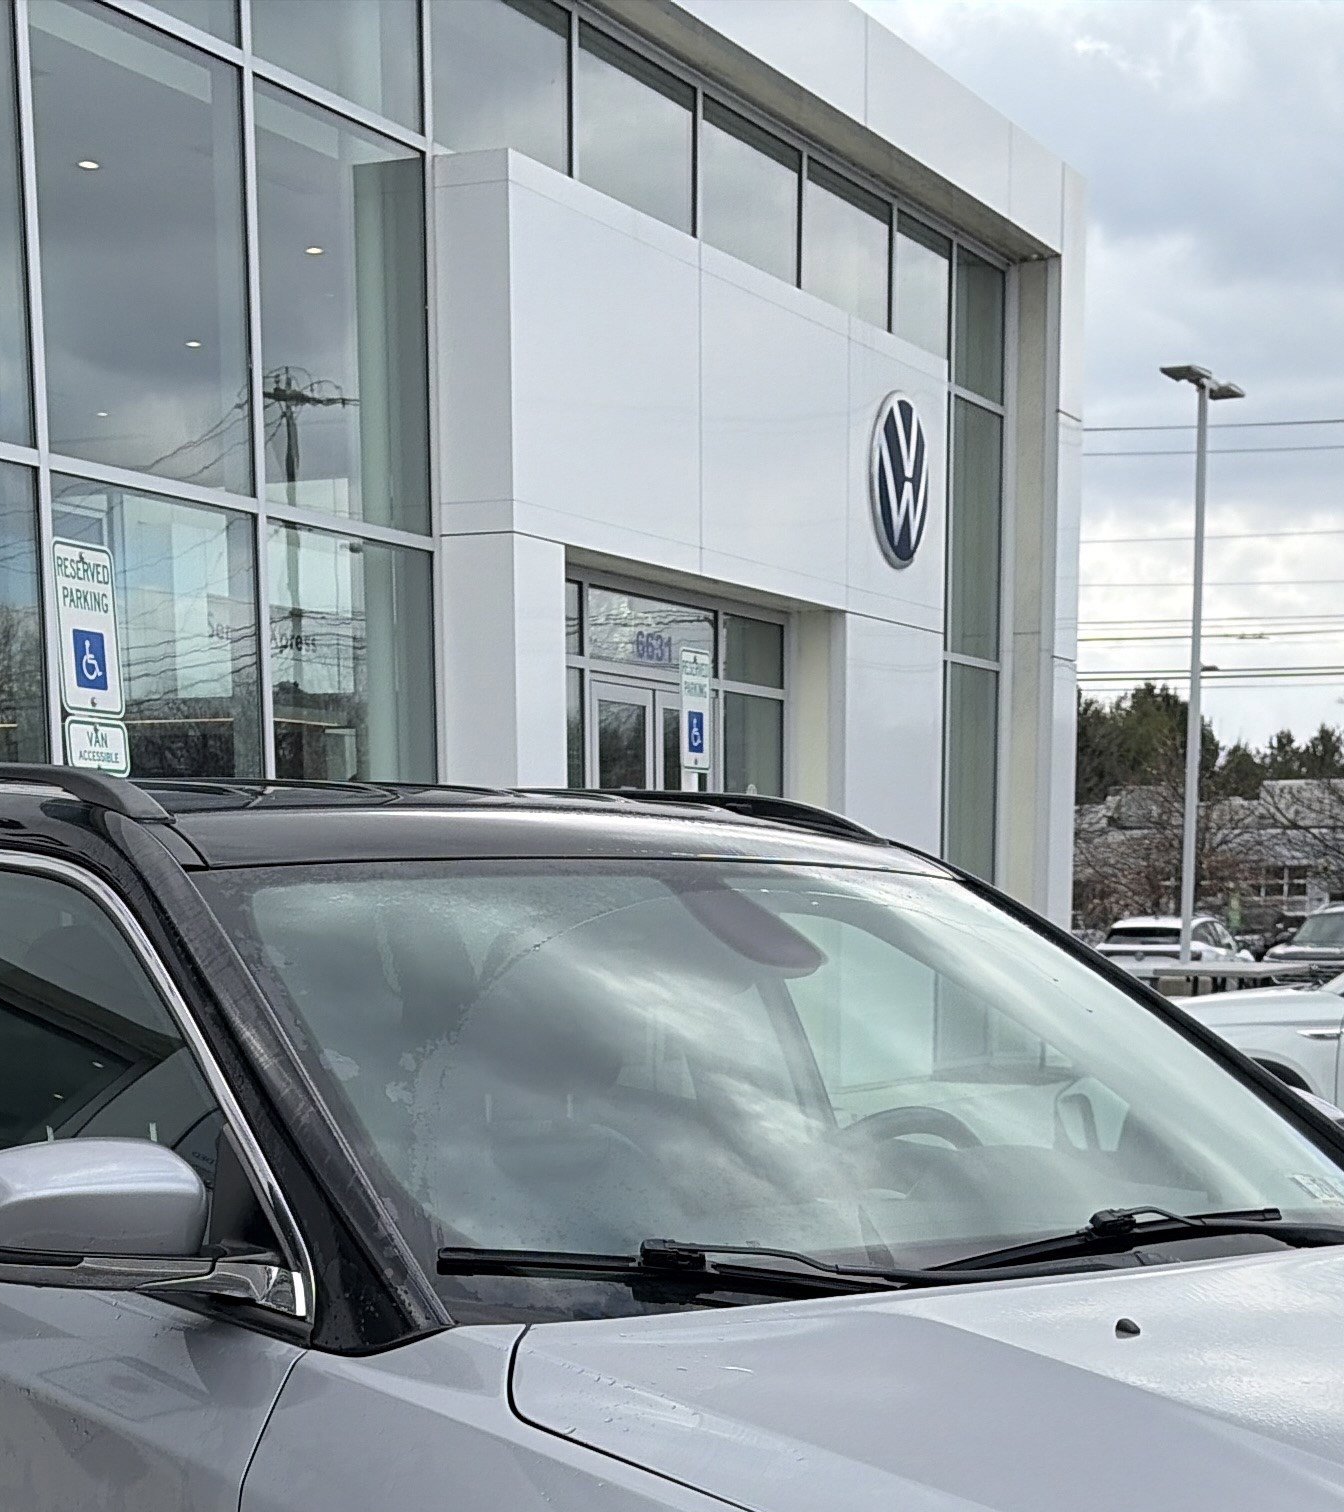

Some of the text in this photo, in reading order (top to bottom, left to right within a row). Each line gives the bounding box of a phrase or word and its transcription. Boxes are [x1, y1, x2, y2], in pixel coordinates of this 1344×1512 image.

[56, 556, 109, 585] RESERVED
[62, 586, 109, 614] PARKING
[635, 630, 672, 663] 6631
[87, 731, 108, 749] VAN
[79, 749, 120, 764] ACCESSIBLE
